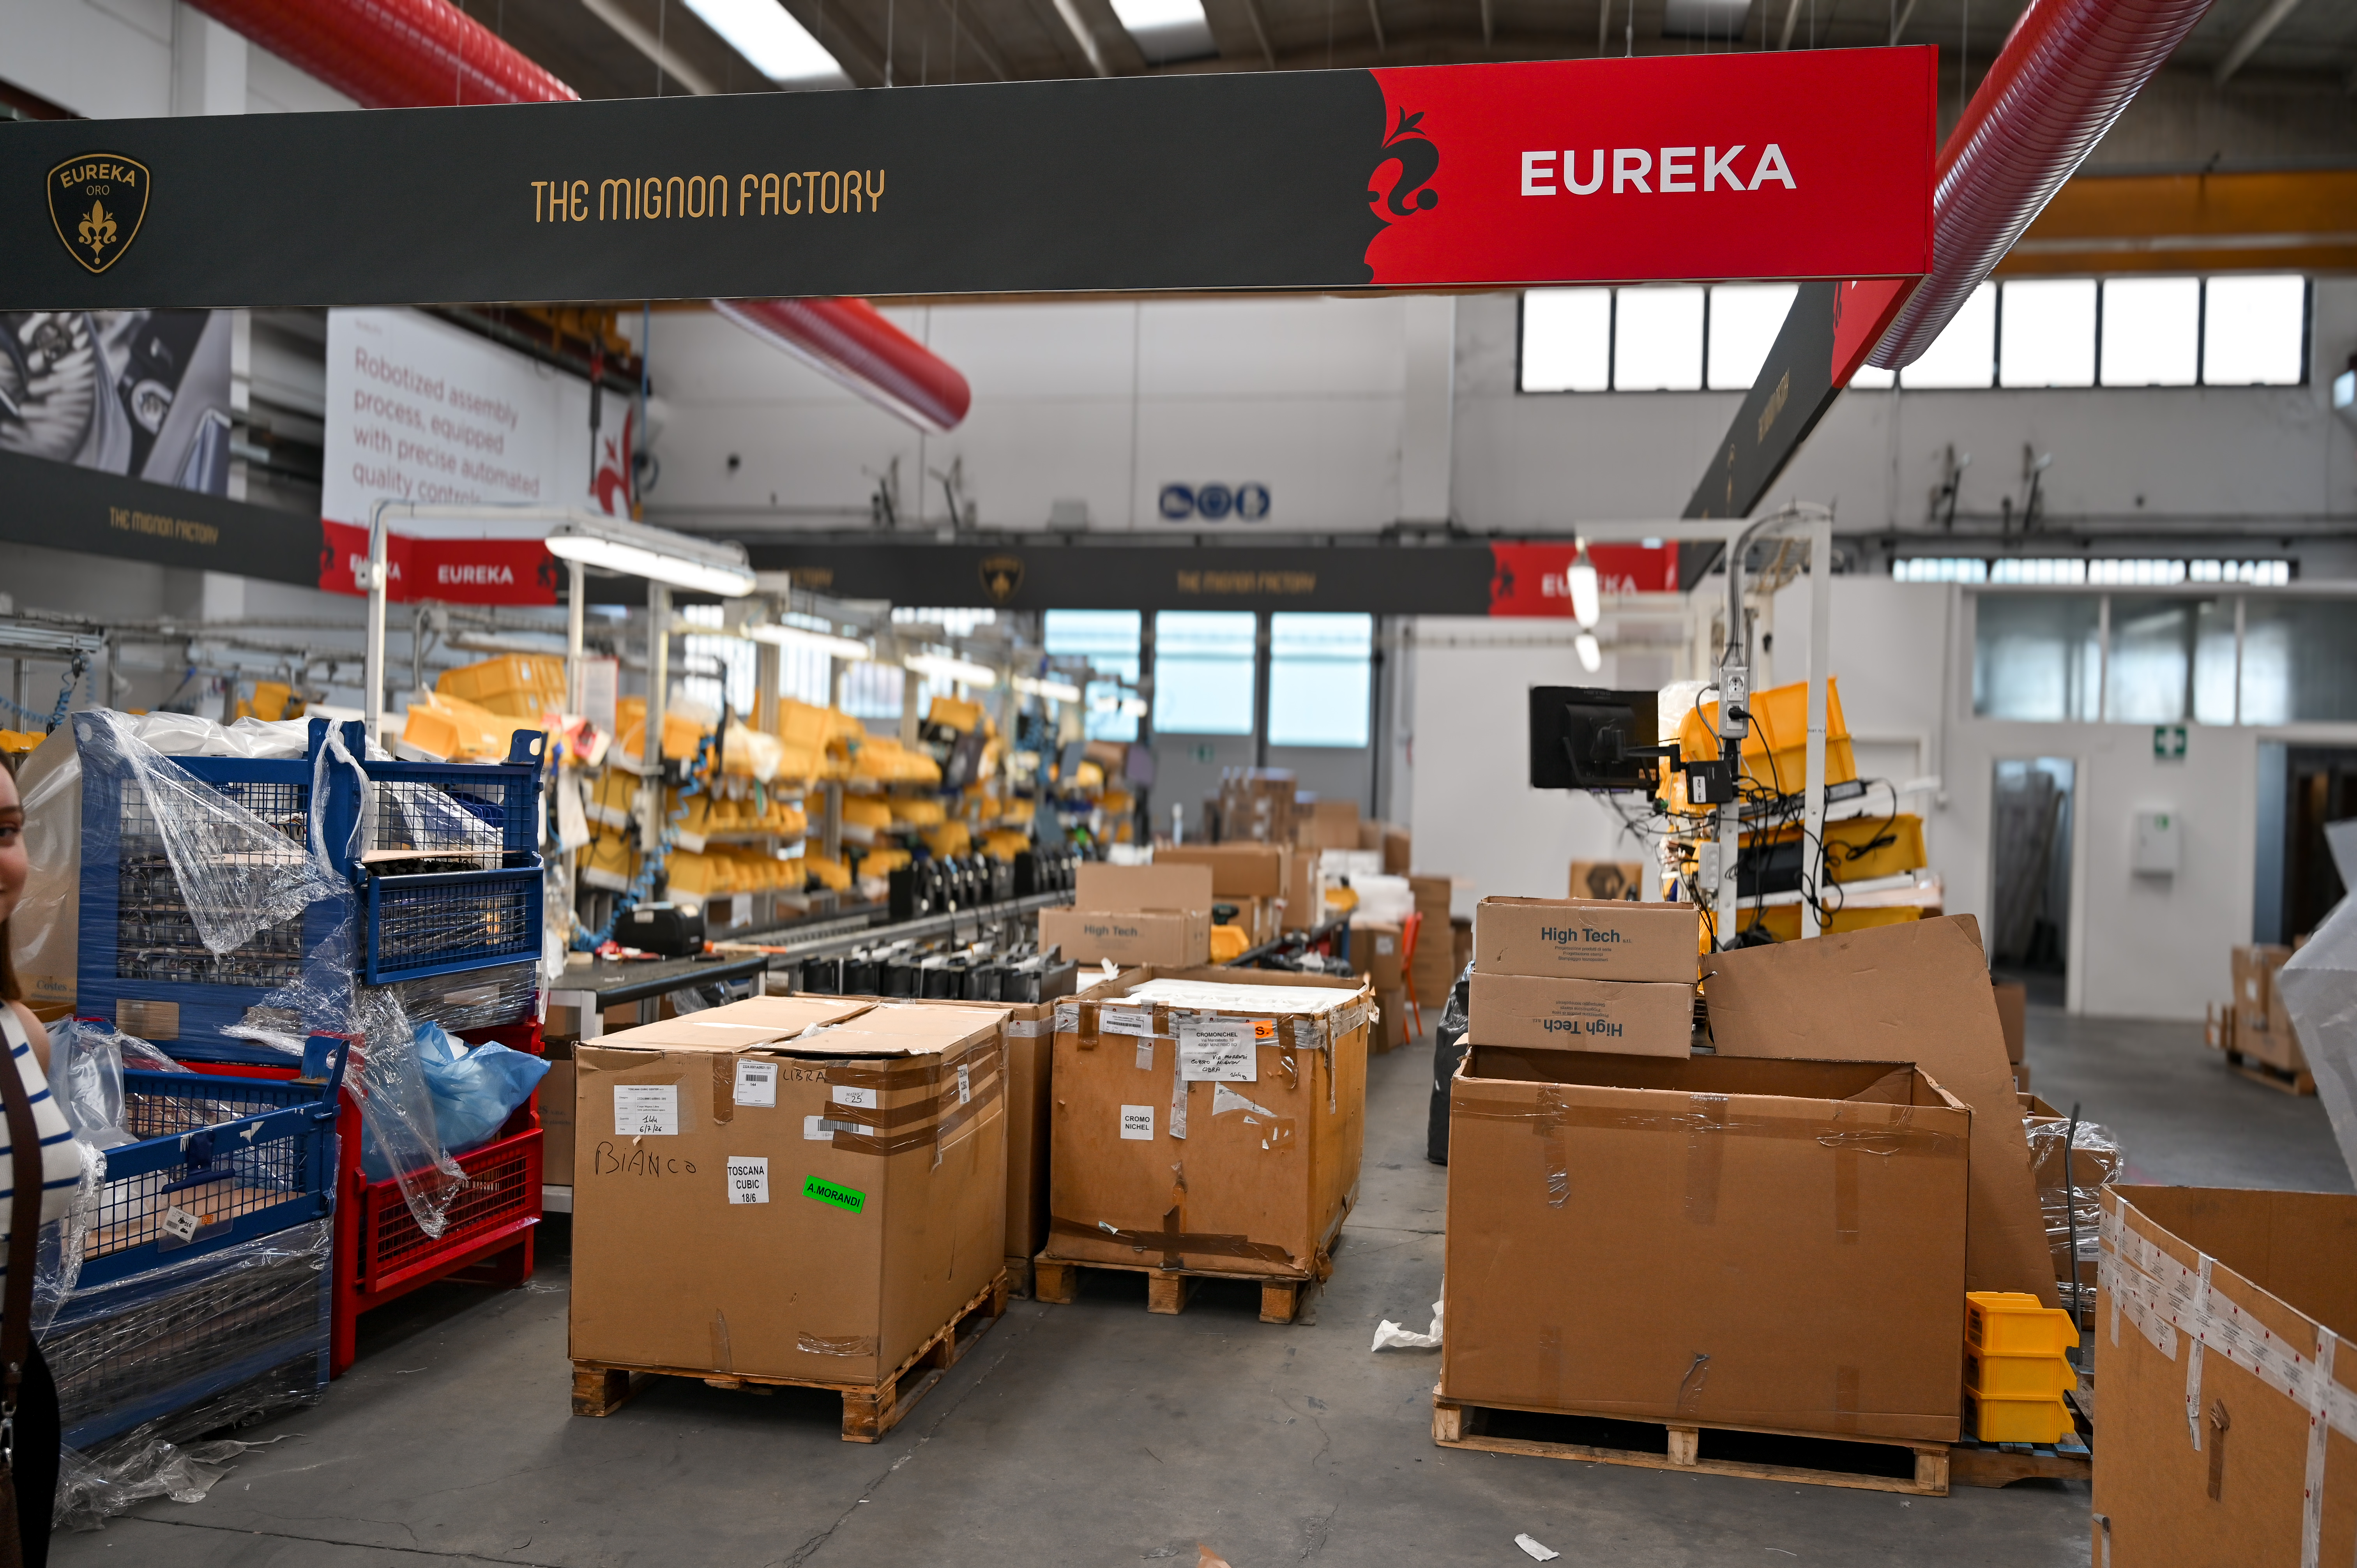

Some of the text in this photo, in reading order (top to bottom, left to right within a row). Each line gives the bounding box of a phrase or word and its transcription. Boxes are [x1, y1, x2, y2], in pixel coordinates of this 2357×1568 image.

[60, 163, 135, 189] EUREKA
[1521, 144, 1797, 196] EUREKA
[87, 185, 110, 196] ORO
[531, 169, 884, 222] THE MIGNON FACTORY
[355, 346, 518, 432] Robotized assembly
[354, 389, 504, 456] process, equipped
[353, 425, 540, 498] with precise automated
[353, 463, 412, 500] quality
[110, 506, 219, 545] THE MIGNON FACTORY
[438, 565, 514, 584] EUREKA
[1085, 924, 1138, 937] High Tech
[1541, 927, 1577, 944] High
[1582, 928, 1620, 942] Tech
[1544, 1019, 1581, 1034] Tech
[1586, 1019, 1622, 1037] High
[783, 1069, 826, 1082] LIBRA
[728, 1165, 765, 1176] TOSCANA
[736, 1179, 760, 1189] CUBIC
[742, 1193, 756, 1203] 18/6
[807, 1183, 861, 1208] A.MORANDI
